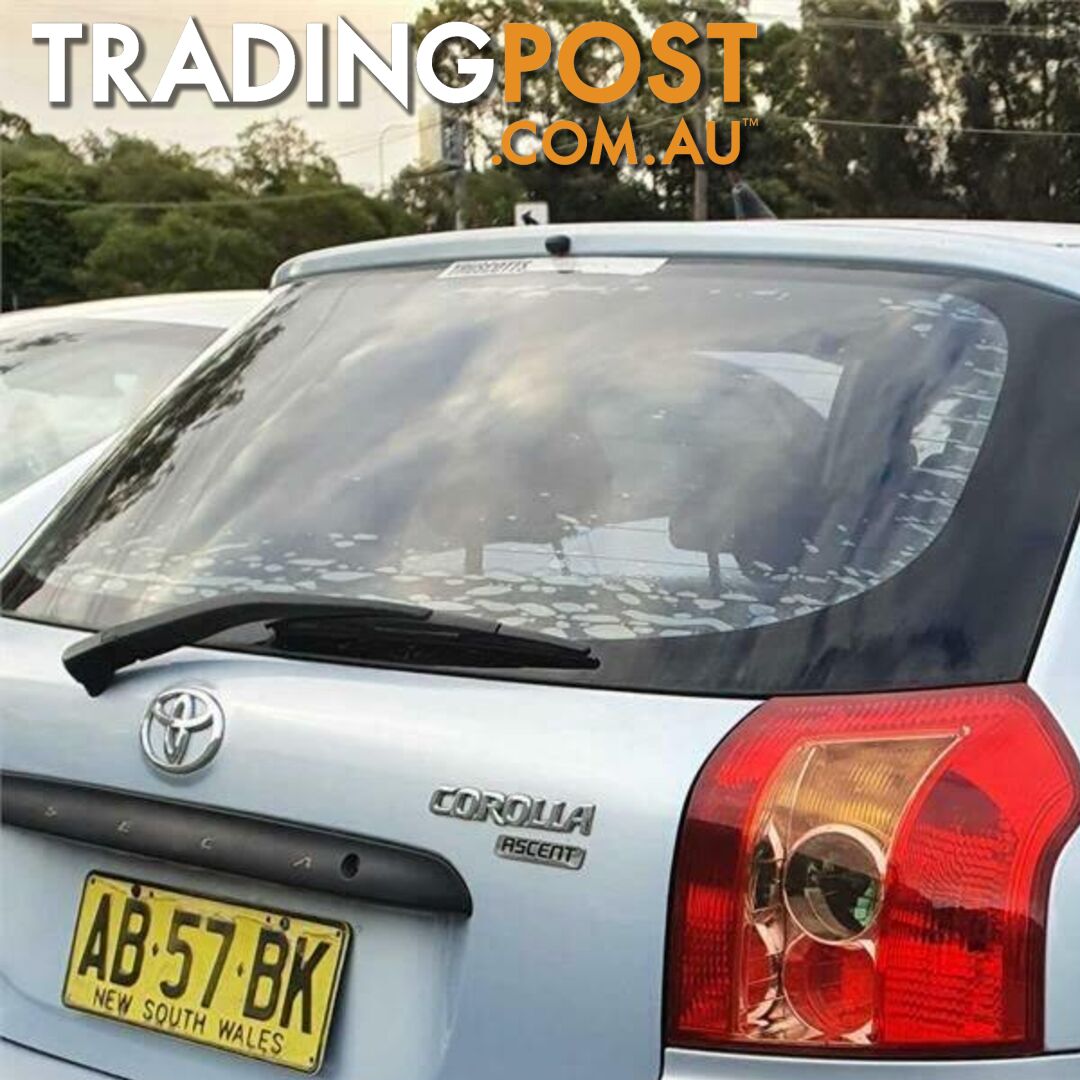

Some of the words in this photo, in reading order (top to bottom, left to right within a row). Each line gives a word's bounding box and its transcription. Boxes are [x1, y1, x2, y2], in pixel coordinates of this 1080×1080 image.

[429, 786, 596, 836] COROLLA
[500, 836, 577, 864] ASCENT
[93, 987, 131, 1016] NEW
[142, 999, 207, 1033] SOUTH
[217, 1020, 285, 1055] WALES
